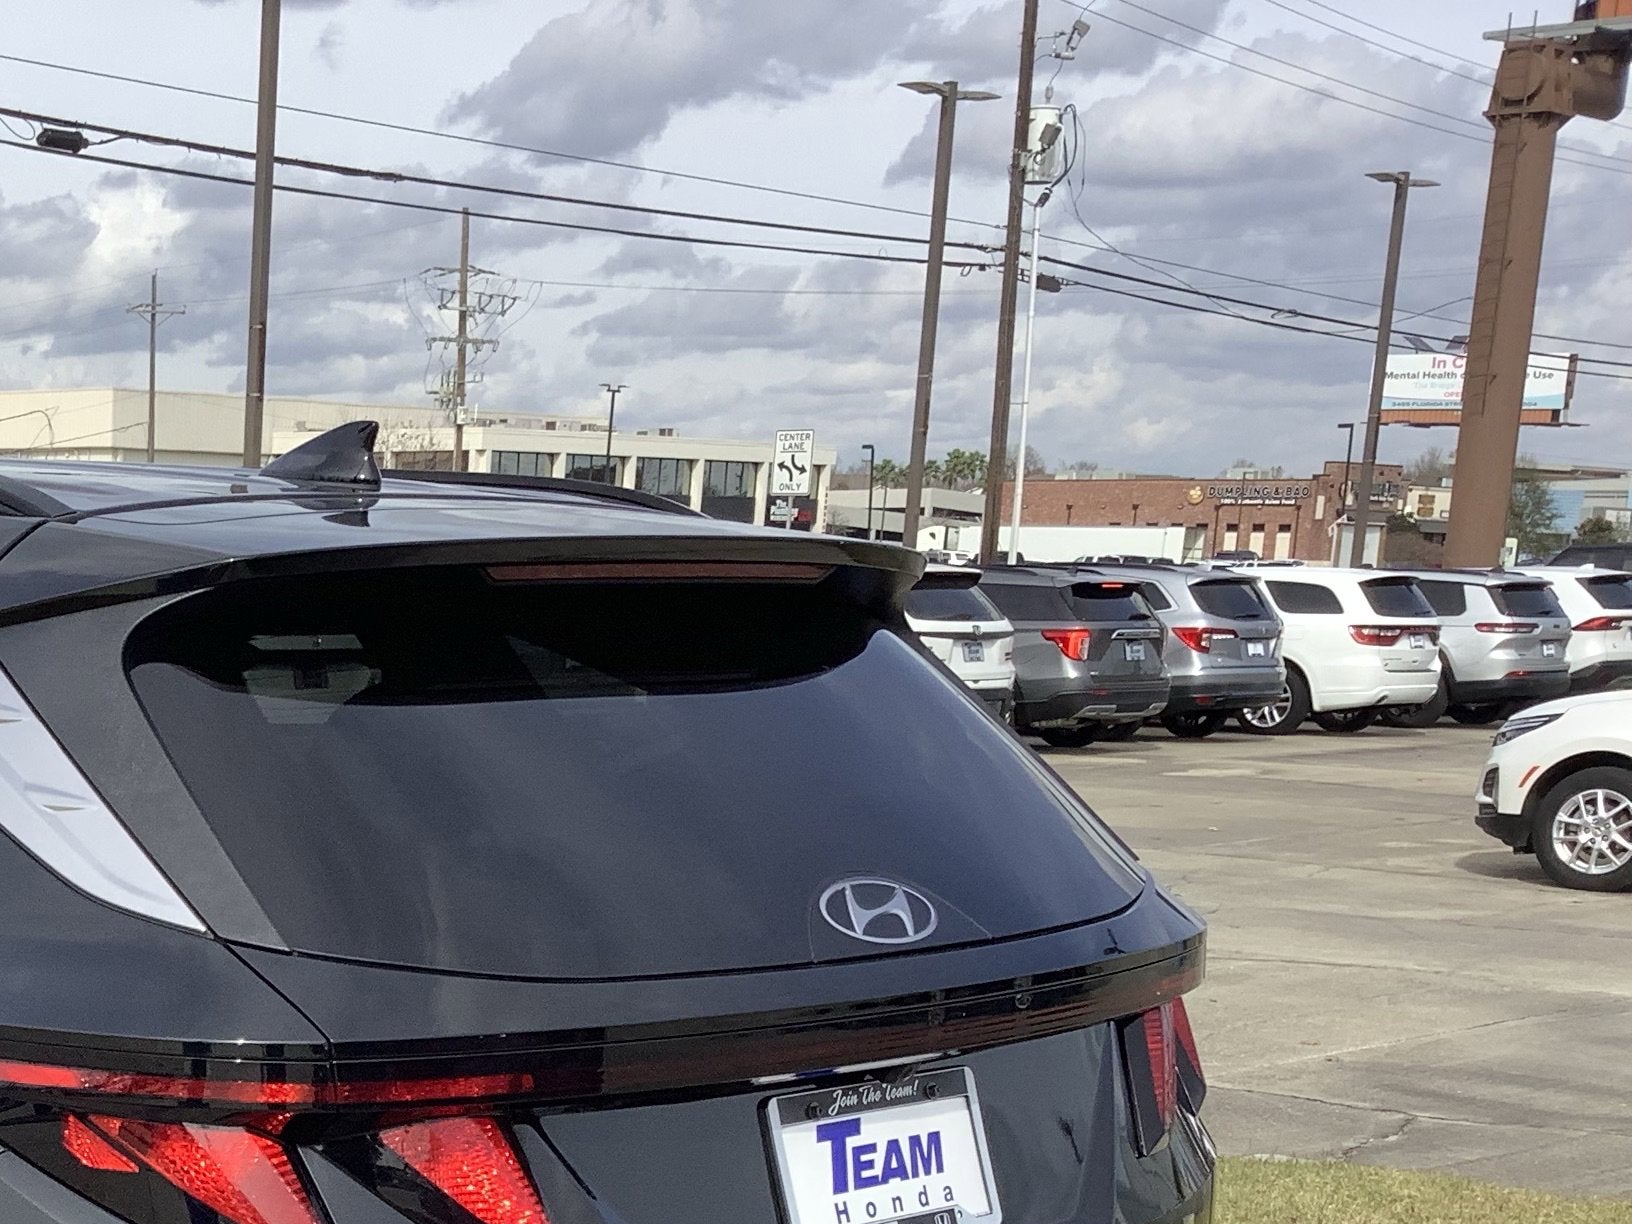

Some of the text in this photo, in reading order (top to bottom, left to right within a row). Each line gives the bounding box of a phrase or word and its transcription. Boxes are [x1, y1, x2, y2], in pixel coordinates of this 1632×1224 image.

[1431, 357, 1446, 369] In
[1386, 371, 1420, 380] Mental
[1423, 371, 1457, 379] Health
[1533, 371, 1554, 380] Use
[778, 433, 811, 441] CENTER
[782, 442, 805, 451] LANE
[778, 483, 802, 491] ONLY
[1208, 486, 1270, 499] DUMPLING
[1284, 486, 1310, 499] BAO
[828, 1088, 859, 1115] Join
[859, 1085, 882, 1106] The
[816, 1117, 944, 1195] TEAM
[834, 1185, 955, 1224] Honda
